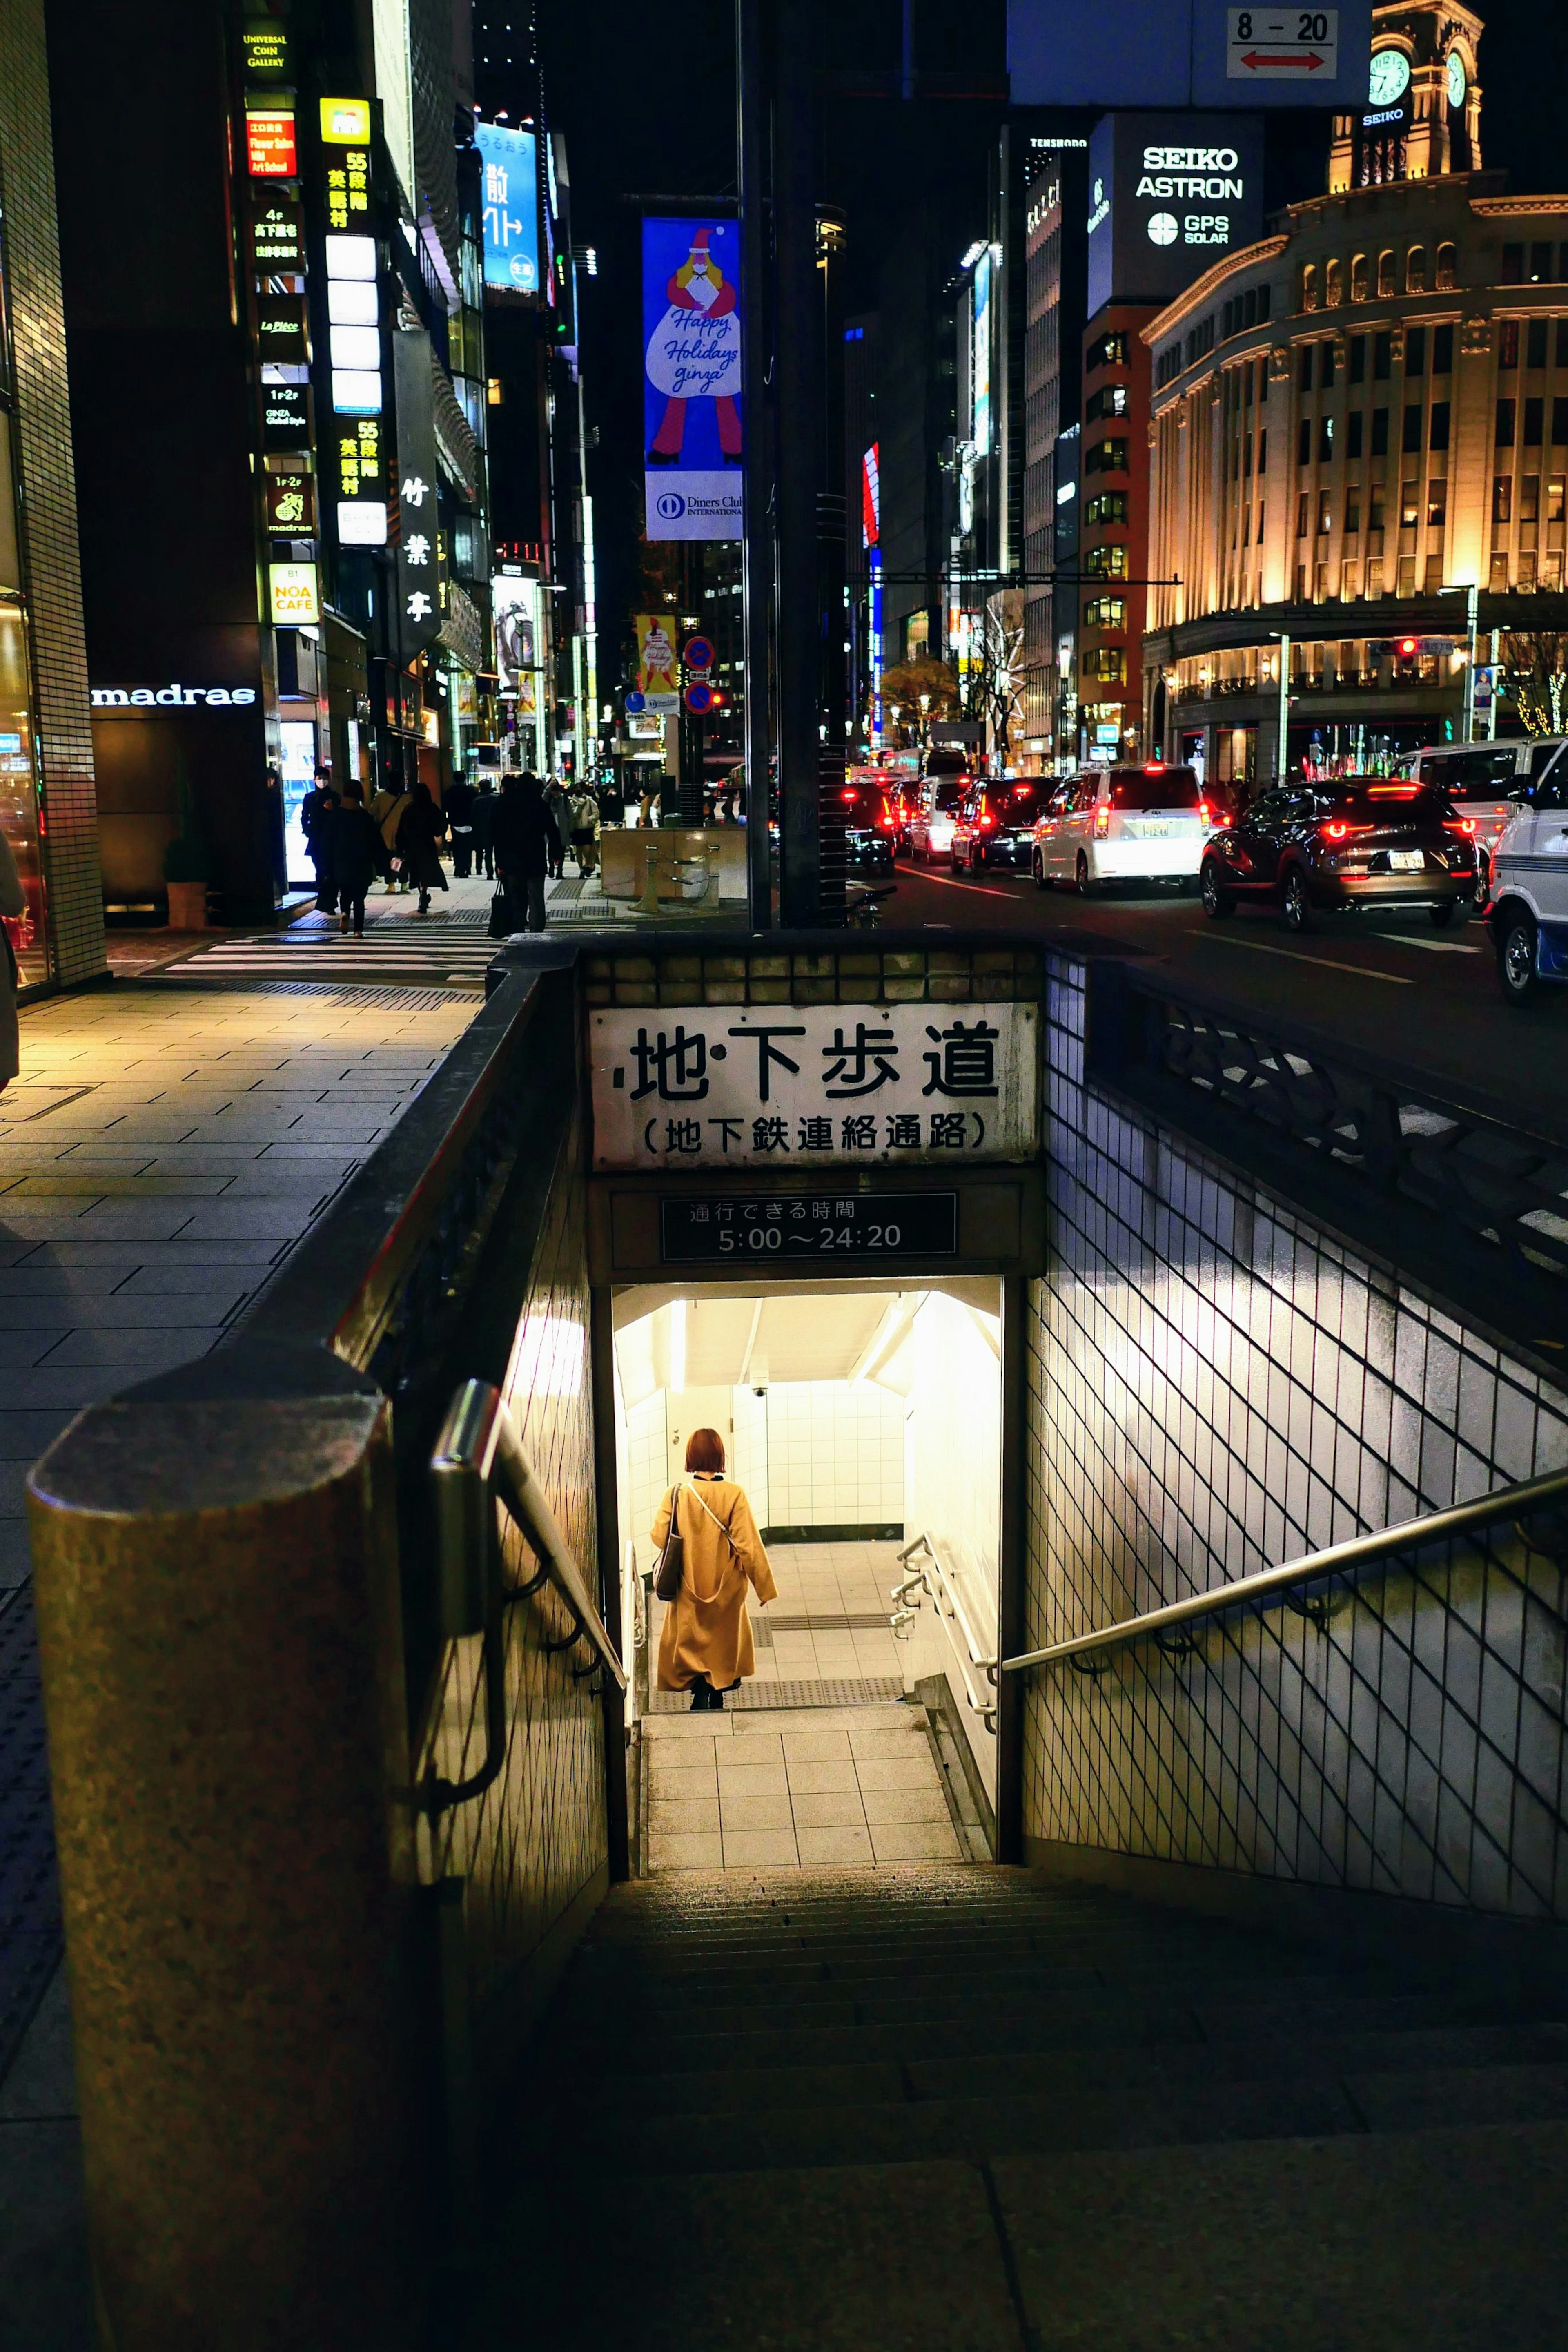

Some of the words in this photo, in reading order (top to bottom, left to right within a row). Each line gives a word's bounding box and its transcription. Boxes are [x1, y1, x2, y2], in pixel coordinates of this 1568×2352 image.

[1237, 13, 1252, 40] 8
[1298, 14, 1328, 41] 20
[243, 35, 287, 44] UNIVERSAL
[253, 46, 278, 55] COIN
[247, 58, 284, 67] GALLERY
[1363, 109, 1403, 126] SEIKO
[1143, 147, 1238, 171] SEIKO
[1136, 177, 1243, 199] ASTRON
[1185, 216, 1229, 232] GPS
[1185, 233, 1228, 244] SOLAR
[671, 309, 731, 338] Happy
[664, 340, 737, 370] Holidays
[673, 366, 724, 393] ginza
[688, 496, 720, 507] Diners
[401, 477, 432, 622] 竹葉亭
[275, 586, 311, 597] NOA
[276, 600, 312, 609] CAFE
[91, 684, 256, 706] madras
[629, 1020, 999, 1102] 地下歩道
[644, 1112, 985, 1154] （地下鉄連絡通路）
[690, 1200, 855, 1224] 通行できる時間
